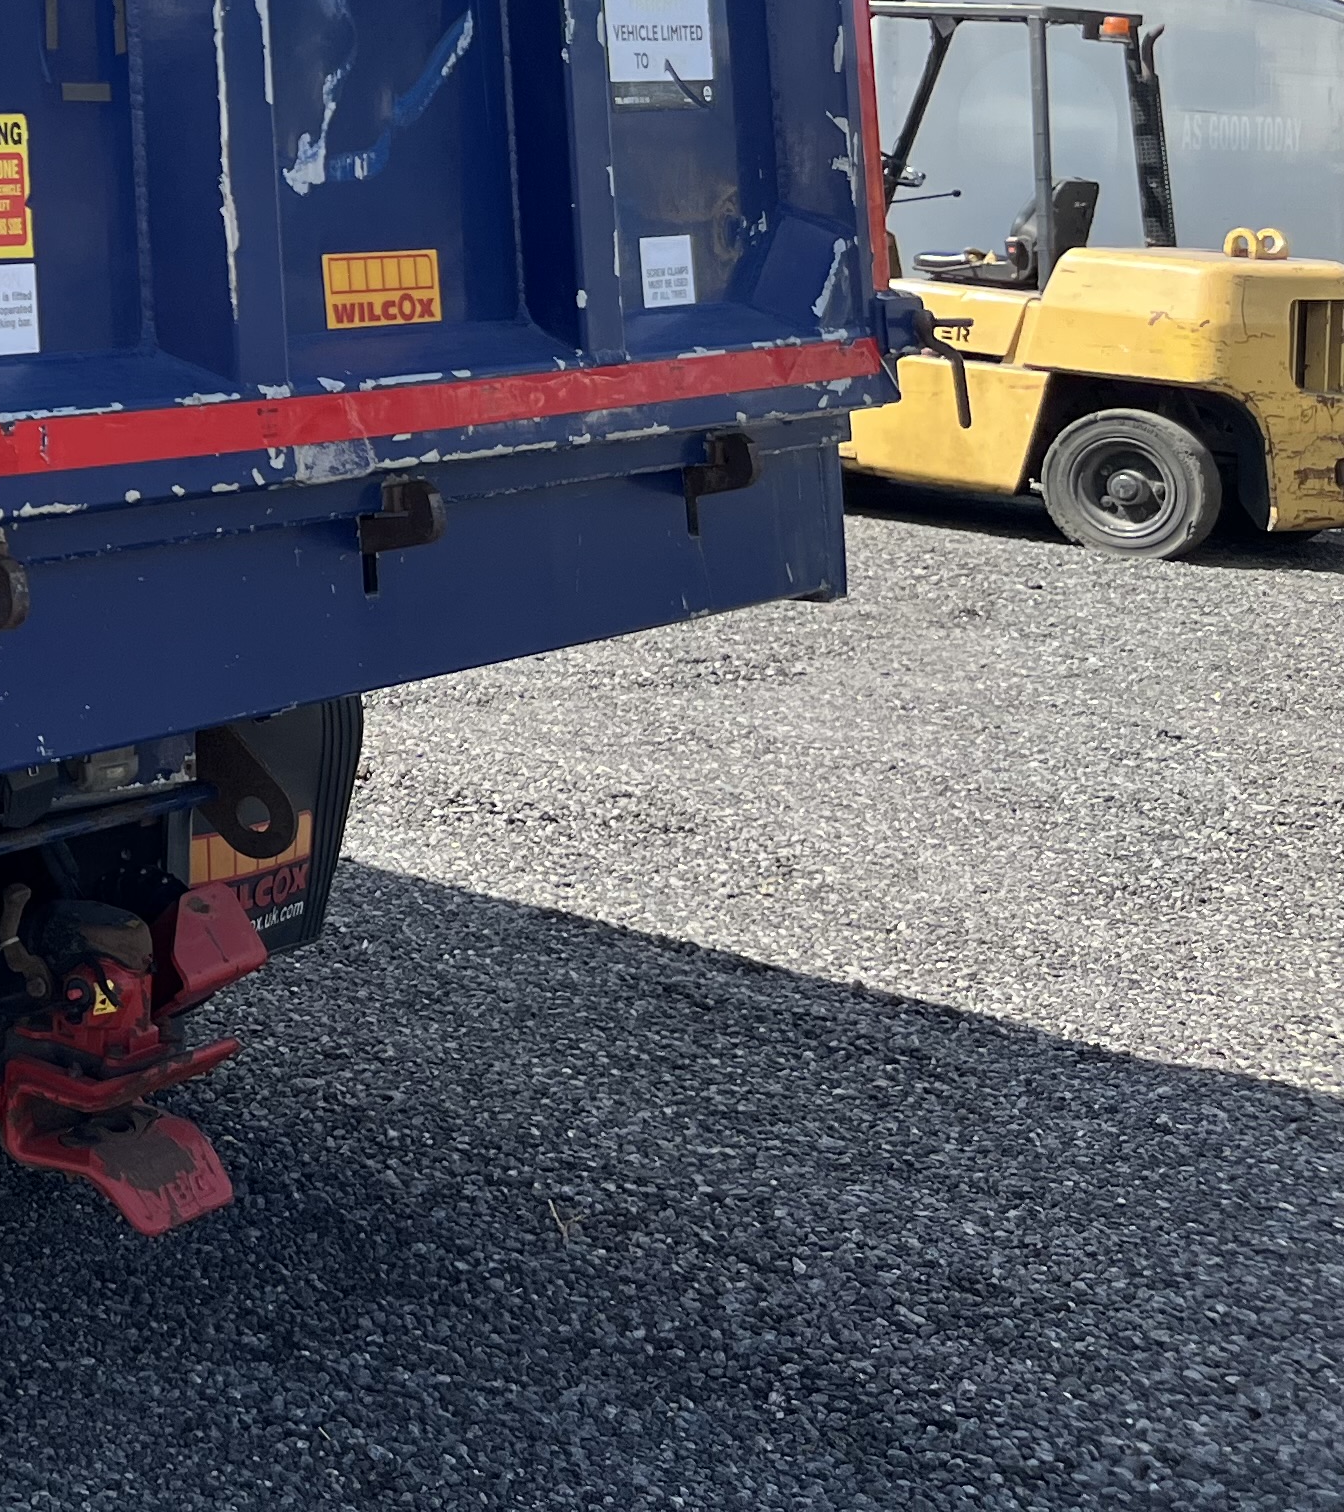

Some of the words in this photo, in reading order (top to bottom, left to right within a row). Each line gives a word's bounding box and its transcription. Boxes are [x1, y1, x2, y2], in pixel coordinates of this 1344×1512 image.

[612, 24, 659, 42] VEHICLE
[661, 24, 703, 41] LIMITED
[633, 52, 649, 69] TO
[1181, 114, 1202, 152] AS
[1208, 114, 1250, 152] GOOD
[1255, 115, 1302, 152] TODAY
[2, 291, 9, 302] is
[331, 292, 436, 325] WILCOX
[233, 863, 310, 911] LCOX
